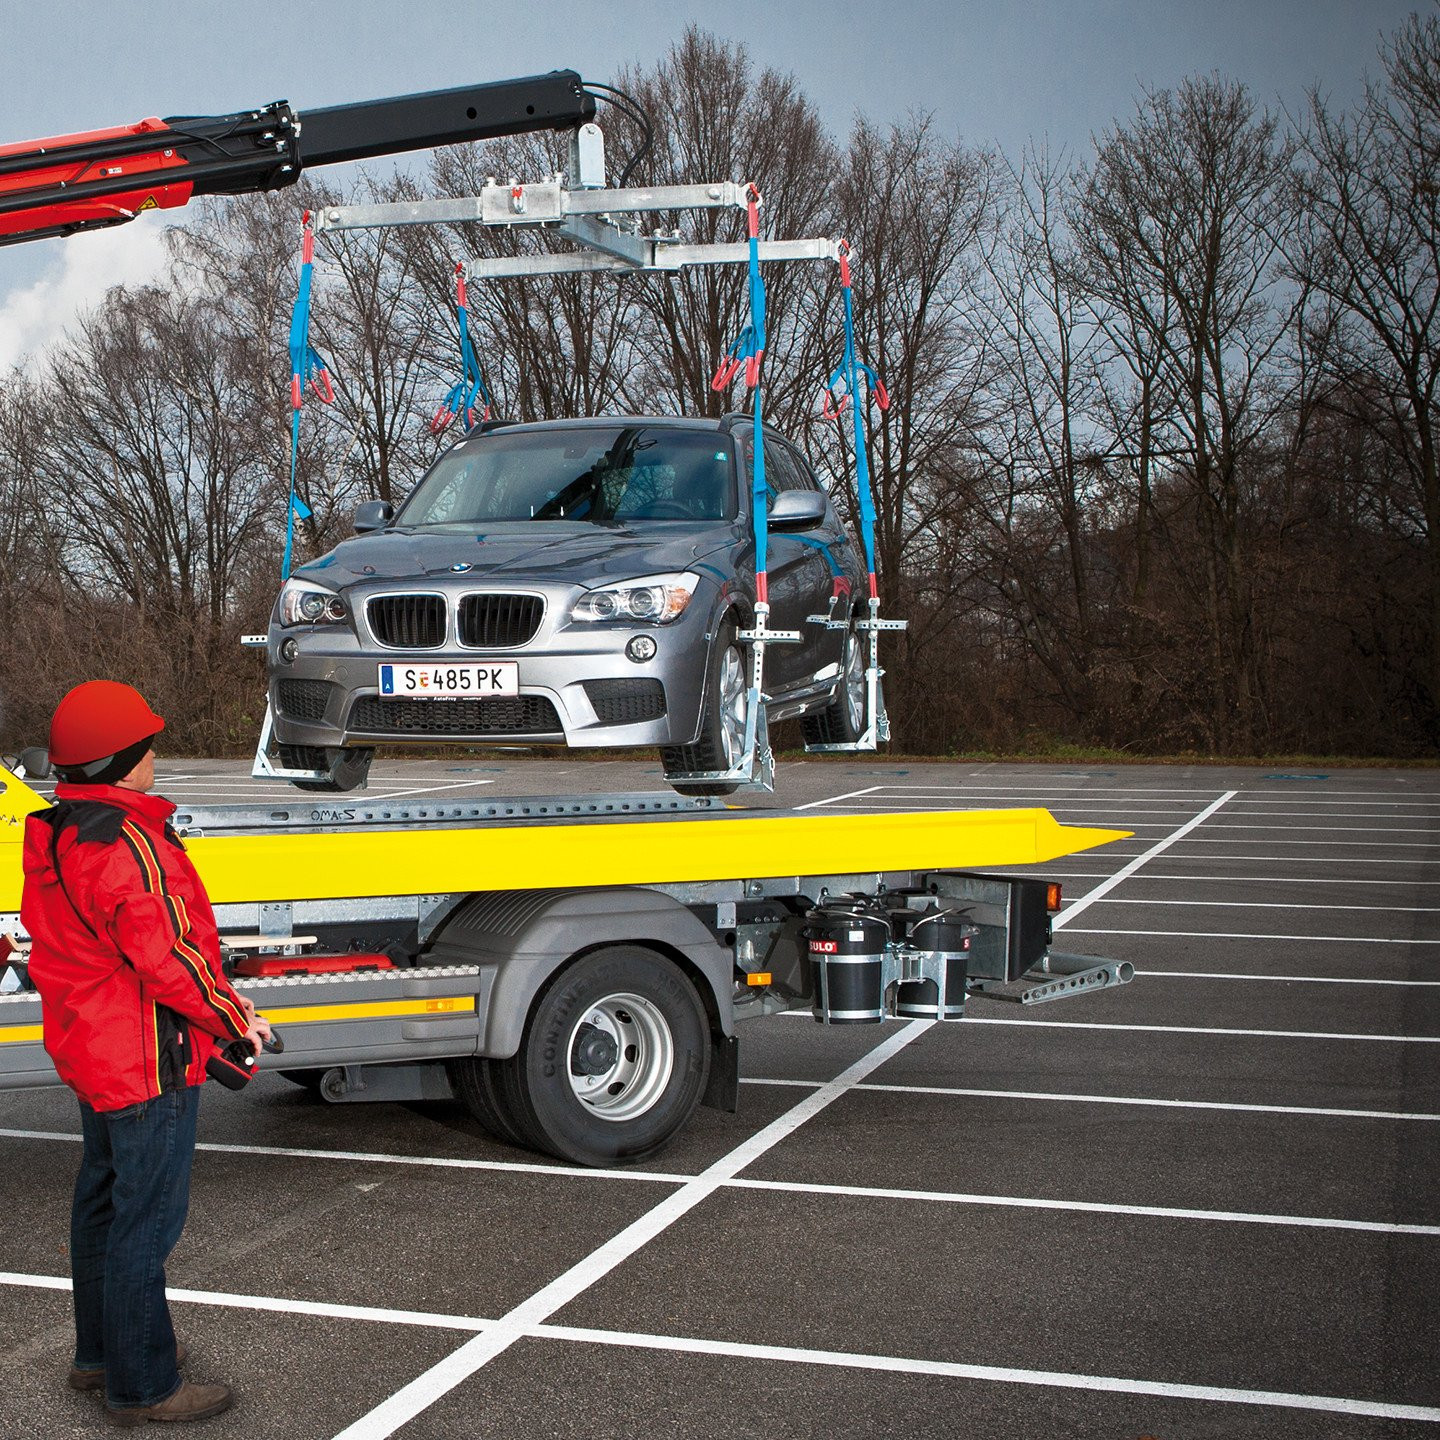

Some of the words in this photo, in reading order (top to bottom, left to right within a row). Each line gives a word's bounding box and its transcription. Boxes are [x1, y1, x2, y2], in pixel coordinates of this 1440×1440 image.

[405, 669, 416, 690] S
[433, 669, 471, 690] 485
[477, 668, 503, 690] PK
